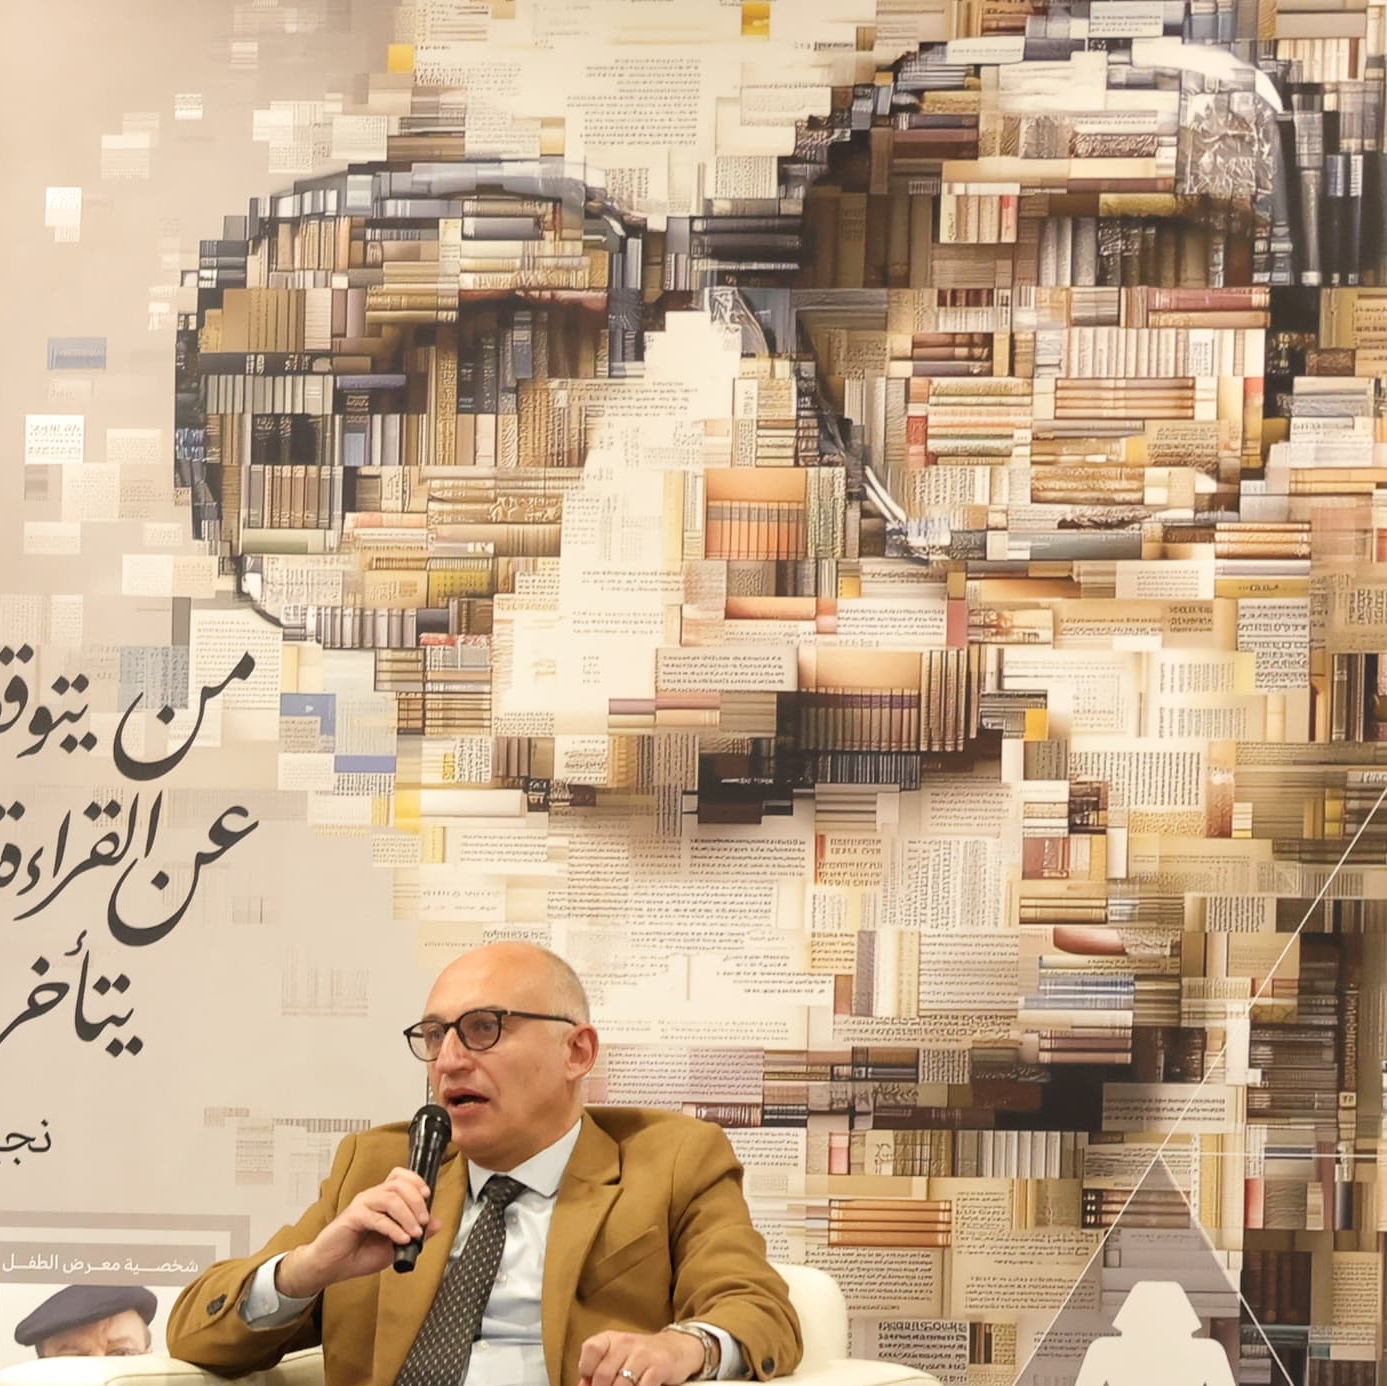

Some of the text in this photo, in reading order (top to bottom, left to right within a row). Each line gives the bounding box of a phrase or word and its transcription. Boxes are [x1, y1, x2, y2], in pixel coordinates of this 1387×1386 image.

[113, 651, 257, 781] من
[107, 805, 260, 947] عن
[2, 1252, 199, 1276] شخصية معرض الطفل
